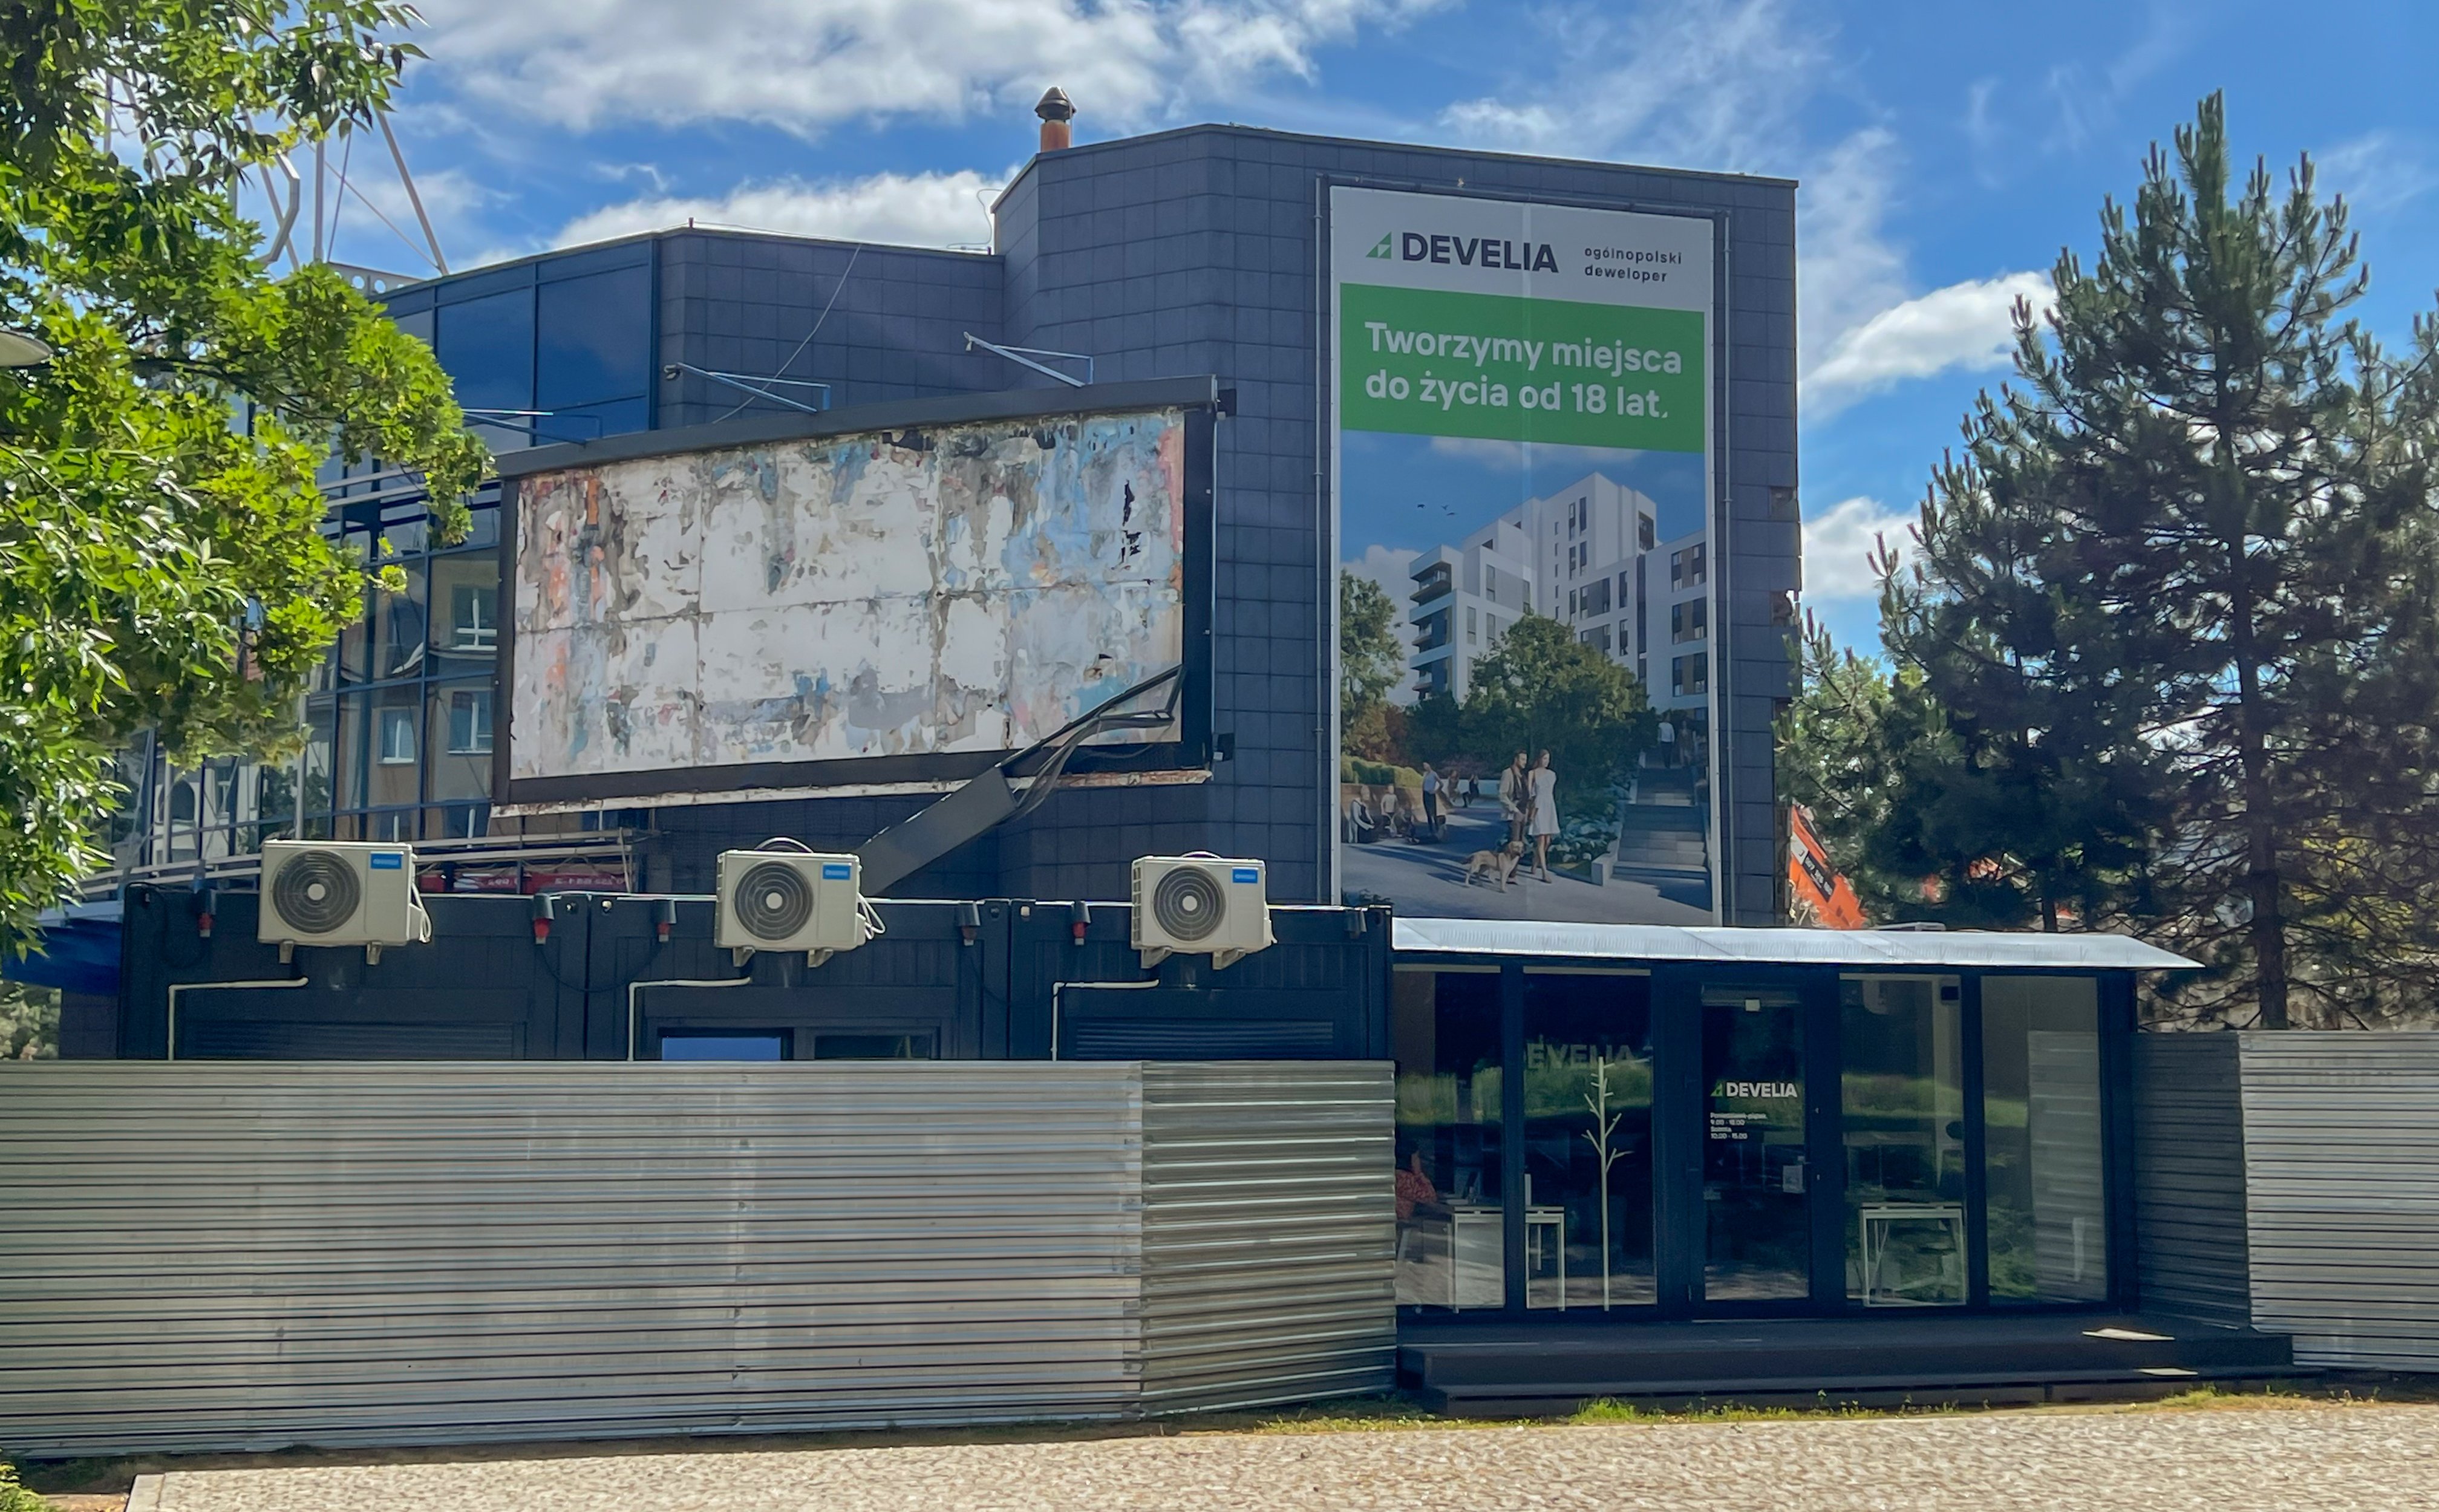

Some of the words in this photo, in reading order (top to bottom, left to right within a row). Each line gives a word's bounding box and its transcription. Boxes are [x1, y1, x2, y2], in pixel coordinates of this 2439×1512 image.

[1402, 232, 1559, 273] DEVELIA
[1584, 247, 1682, 265] ogólnopolski
[1584, 264, 1668, 284] deweloper
[1365, 321, 1544, 371] Tworzymy
[1552, 337, 1682, 377] miejsca
[1365, 369, 1410, 400] do
[1419, 370, 1509, 411] życia
[1518, 381, 1561, 411] od
[1571, 383, 1607, 414] 18
[1617, 386, 1668, 419] lat.
[1523, 1043, 1634, 1069] EVELIA
[1726, 1081, 1798, 1098] DEVELIA
